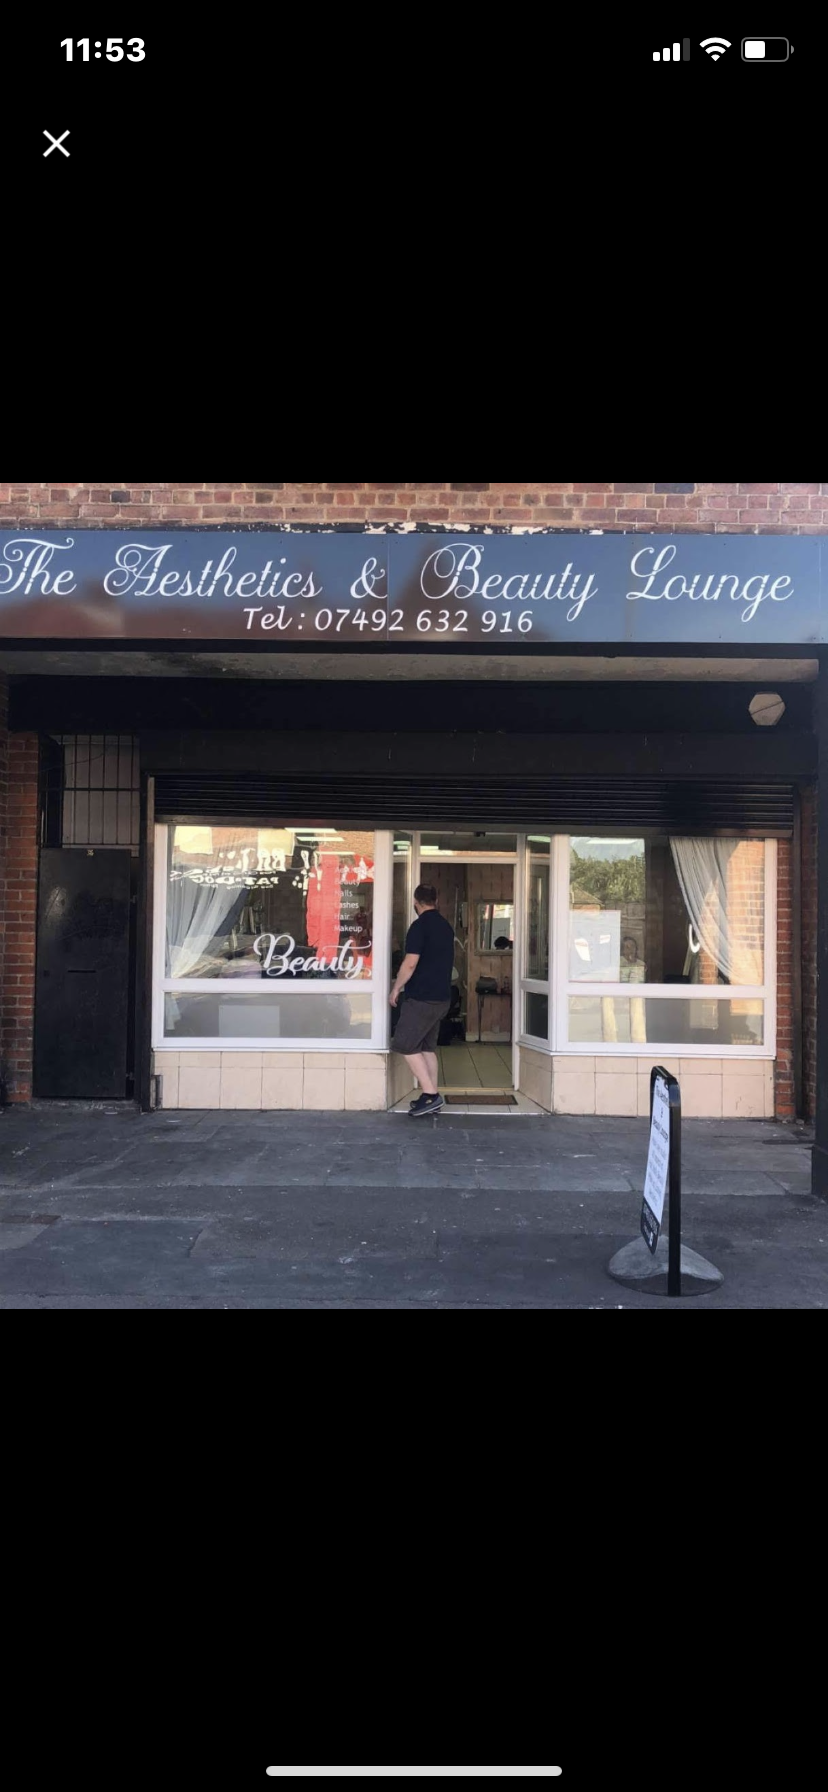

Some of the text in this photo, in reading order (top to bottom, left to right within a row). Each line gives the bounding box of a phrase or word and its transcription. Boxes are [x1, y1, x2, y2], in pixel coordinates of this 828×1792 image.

[0, 537, 794, 622] The Aesthetics & Beauty Lounge
[314, 608, 404, 632] 07492
[416, 610, 469, 633] 632
[481, 610, 534, 633] 916
[253, 933, 372, 979] Beauty
